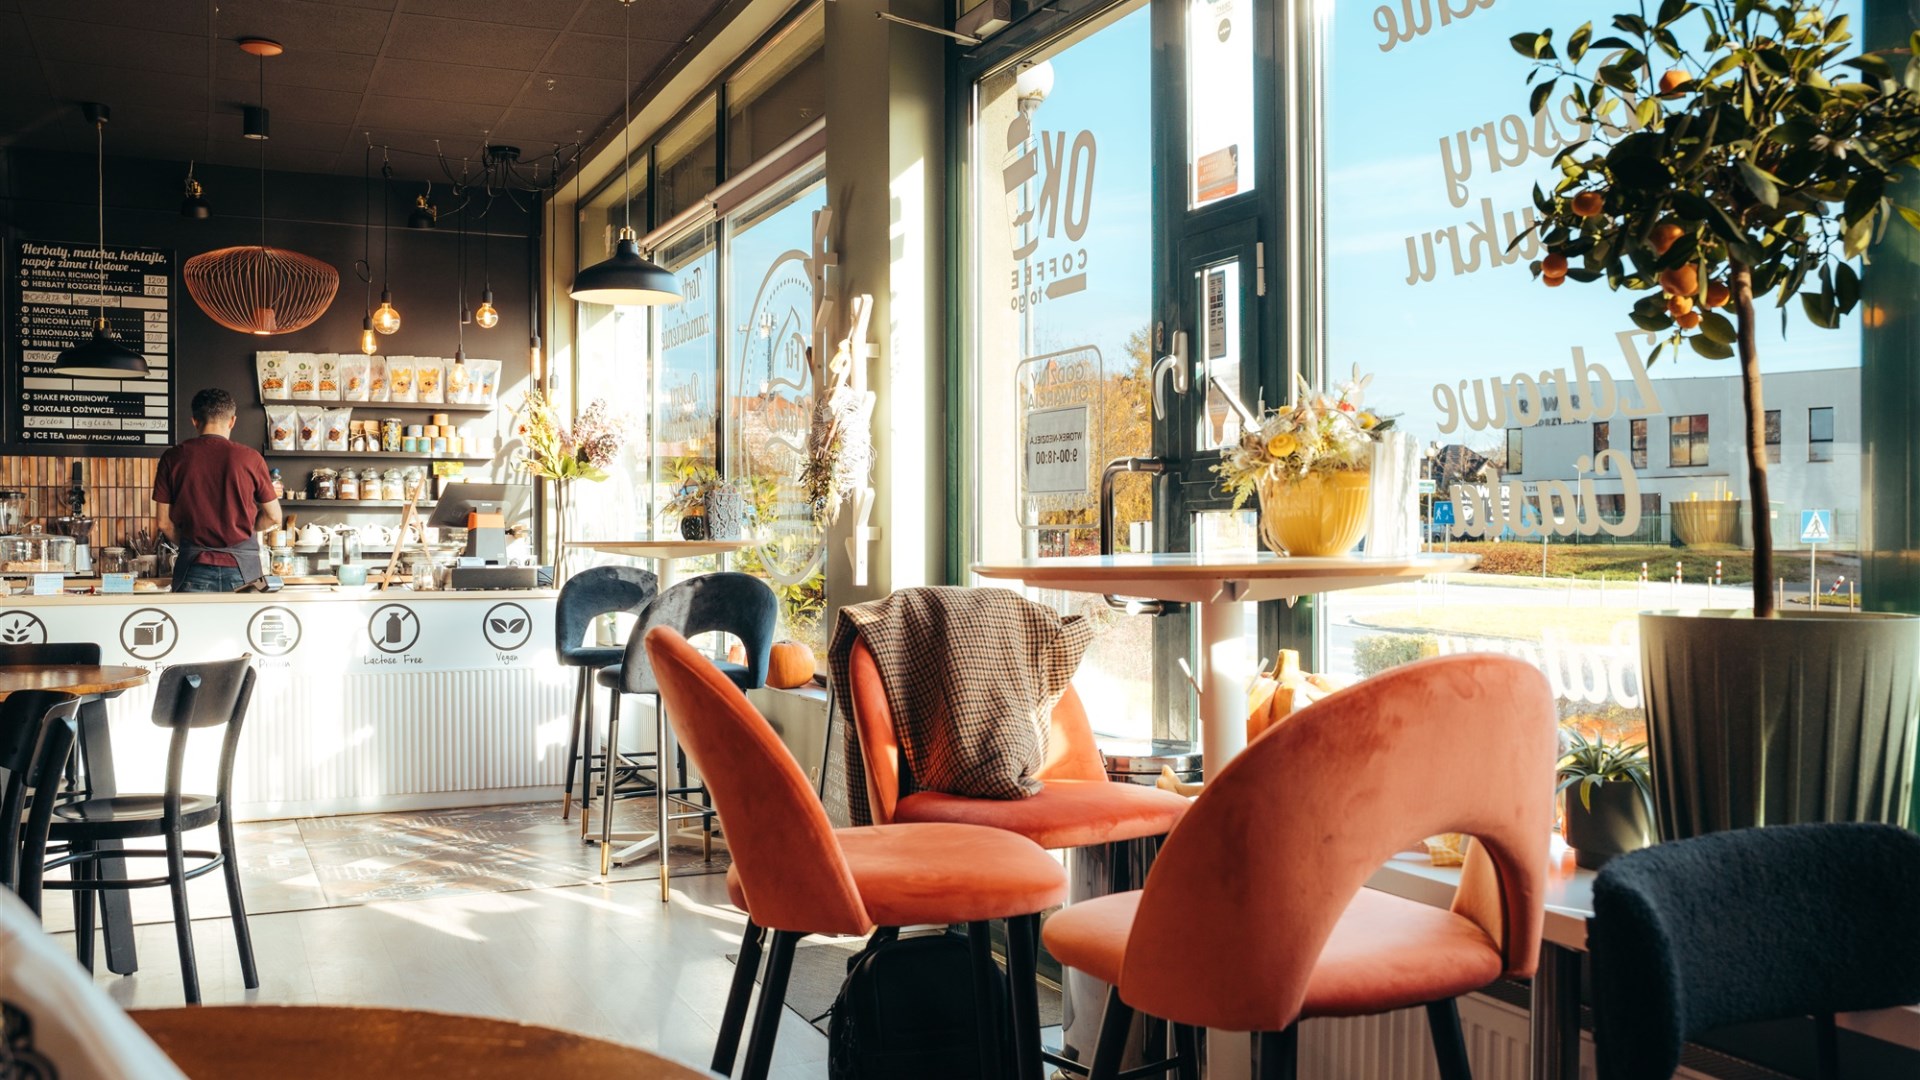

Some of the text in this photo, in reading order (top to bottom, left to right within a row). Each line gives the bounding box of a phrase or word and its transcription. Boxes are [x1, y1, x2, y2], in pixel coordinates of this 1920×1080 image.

[22, 243, 167, 265] Herbaty, matcha, koktajle,
[22, 257, 56, 269] napoje
[58, 259, 88, 269] zimne
[89, 260, 94, 270] i
[95, 261, 129, 272] lodowe
[32, 269, 66, 278] HERBATA
[32, 281, 65, 289] HERBATY
[67, 283, 134, 294] ROZGRZEWAJĄCE
[32, 317, 69, 325] UNICORN
[32, 329, 79, 337] LEMONIADA
[32, 340, 59, 348] BUBBLE
[33, 405, 71, 413] KOKTAJLE
[72, 405, 115, 414] ODŻYWCZE
[363, 654, 424, 665] Lactose Free
[496, 651, 519, 666] Vegan
